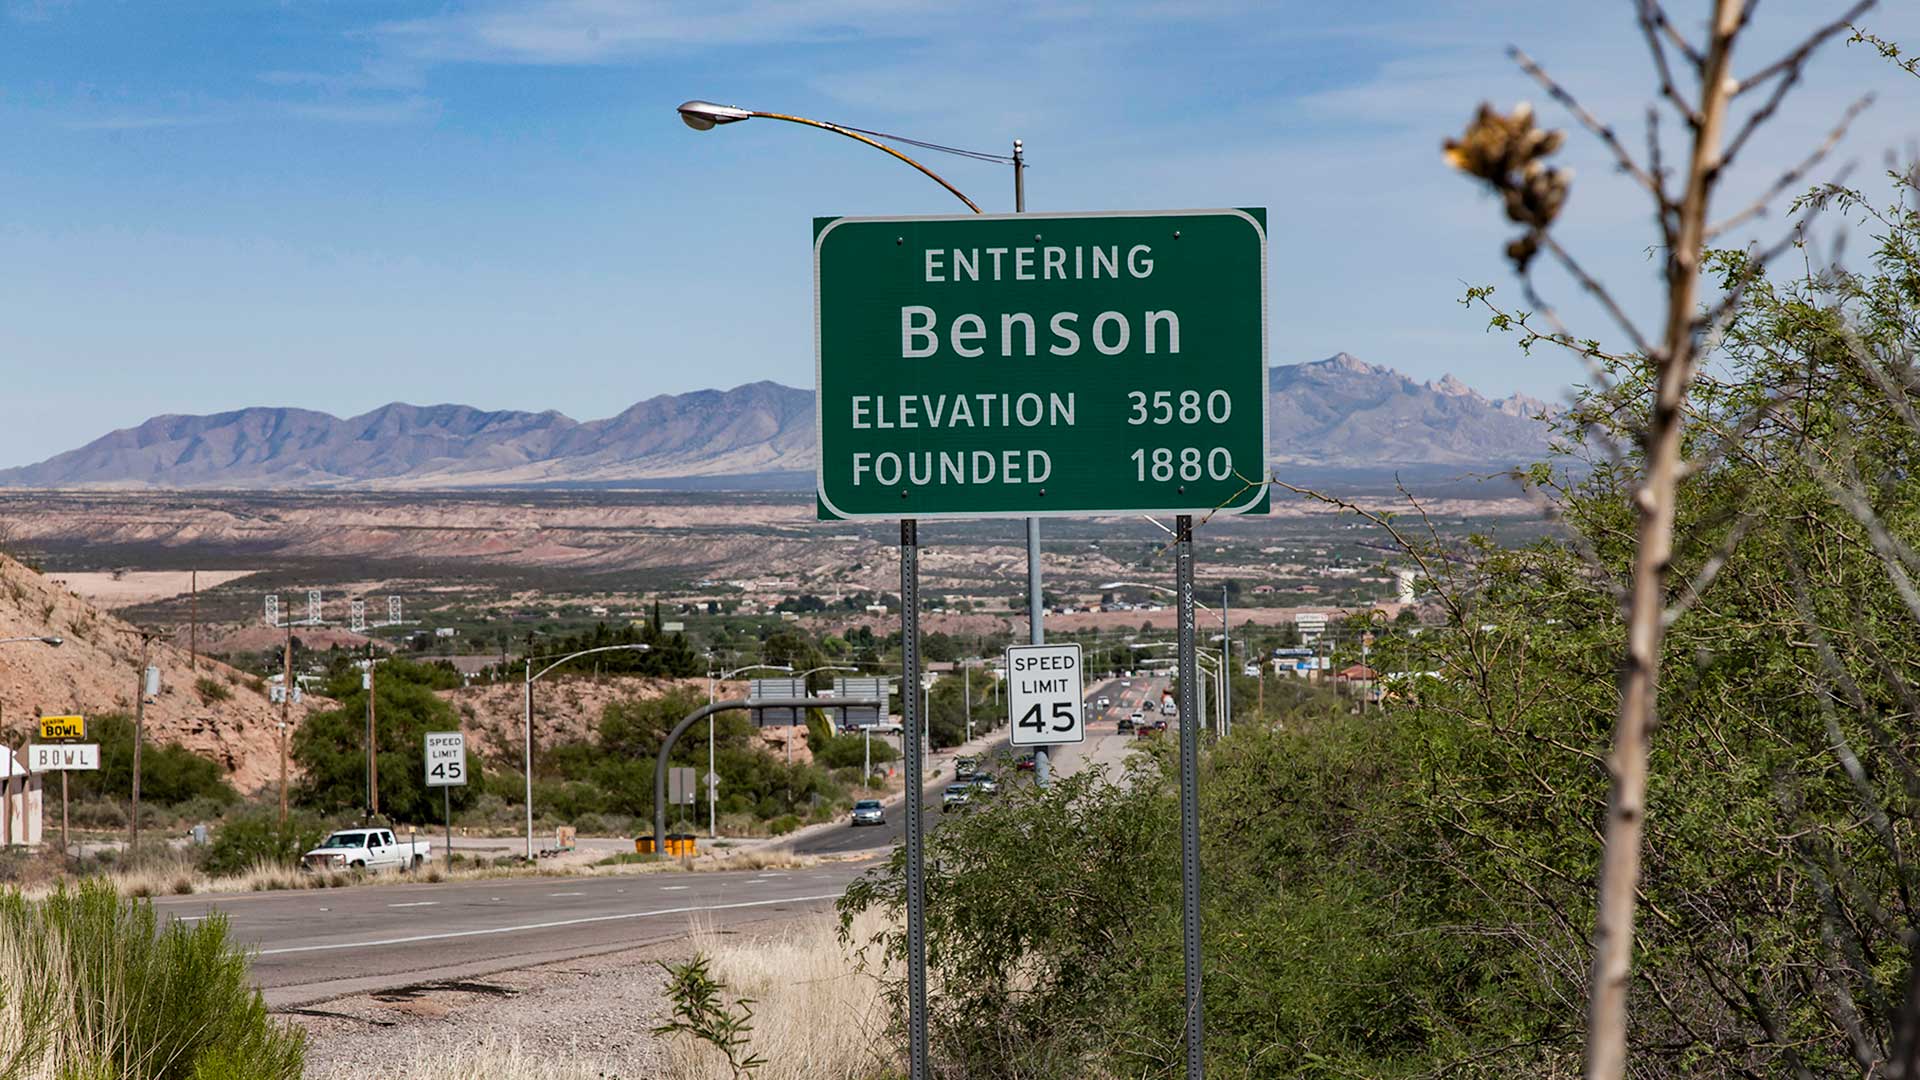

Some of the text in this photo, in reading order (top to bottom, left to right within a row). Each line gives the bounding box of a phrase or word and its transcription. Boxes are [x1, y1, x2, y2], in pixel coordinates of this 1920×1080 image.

[925, 244, 1155, 282] ENTERING
[901, 305, 1181, 358] Benson
[852, 389, 1232, 429] ELEVATION 3580
[852, 446, 1233, 486] FOUNDED 1880
[1015, 656, 1075, 671] SPEED
[1022, 679, 1068, 694] LIMIT
[1018, 702, 1075, 733] 45
[46, 725, 81, 736] BOWL
[429, 737, 461, 746] SPEED
[39, 750, 88, 766] BOWL
[432, 750, 457, 759] LIMIT
[431, 762, 461, 779] 45
